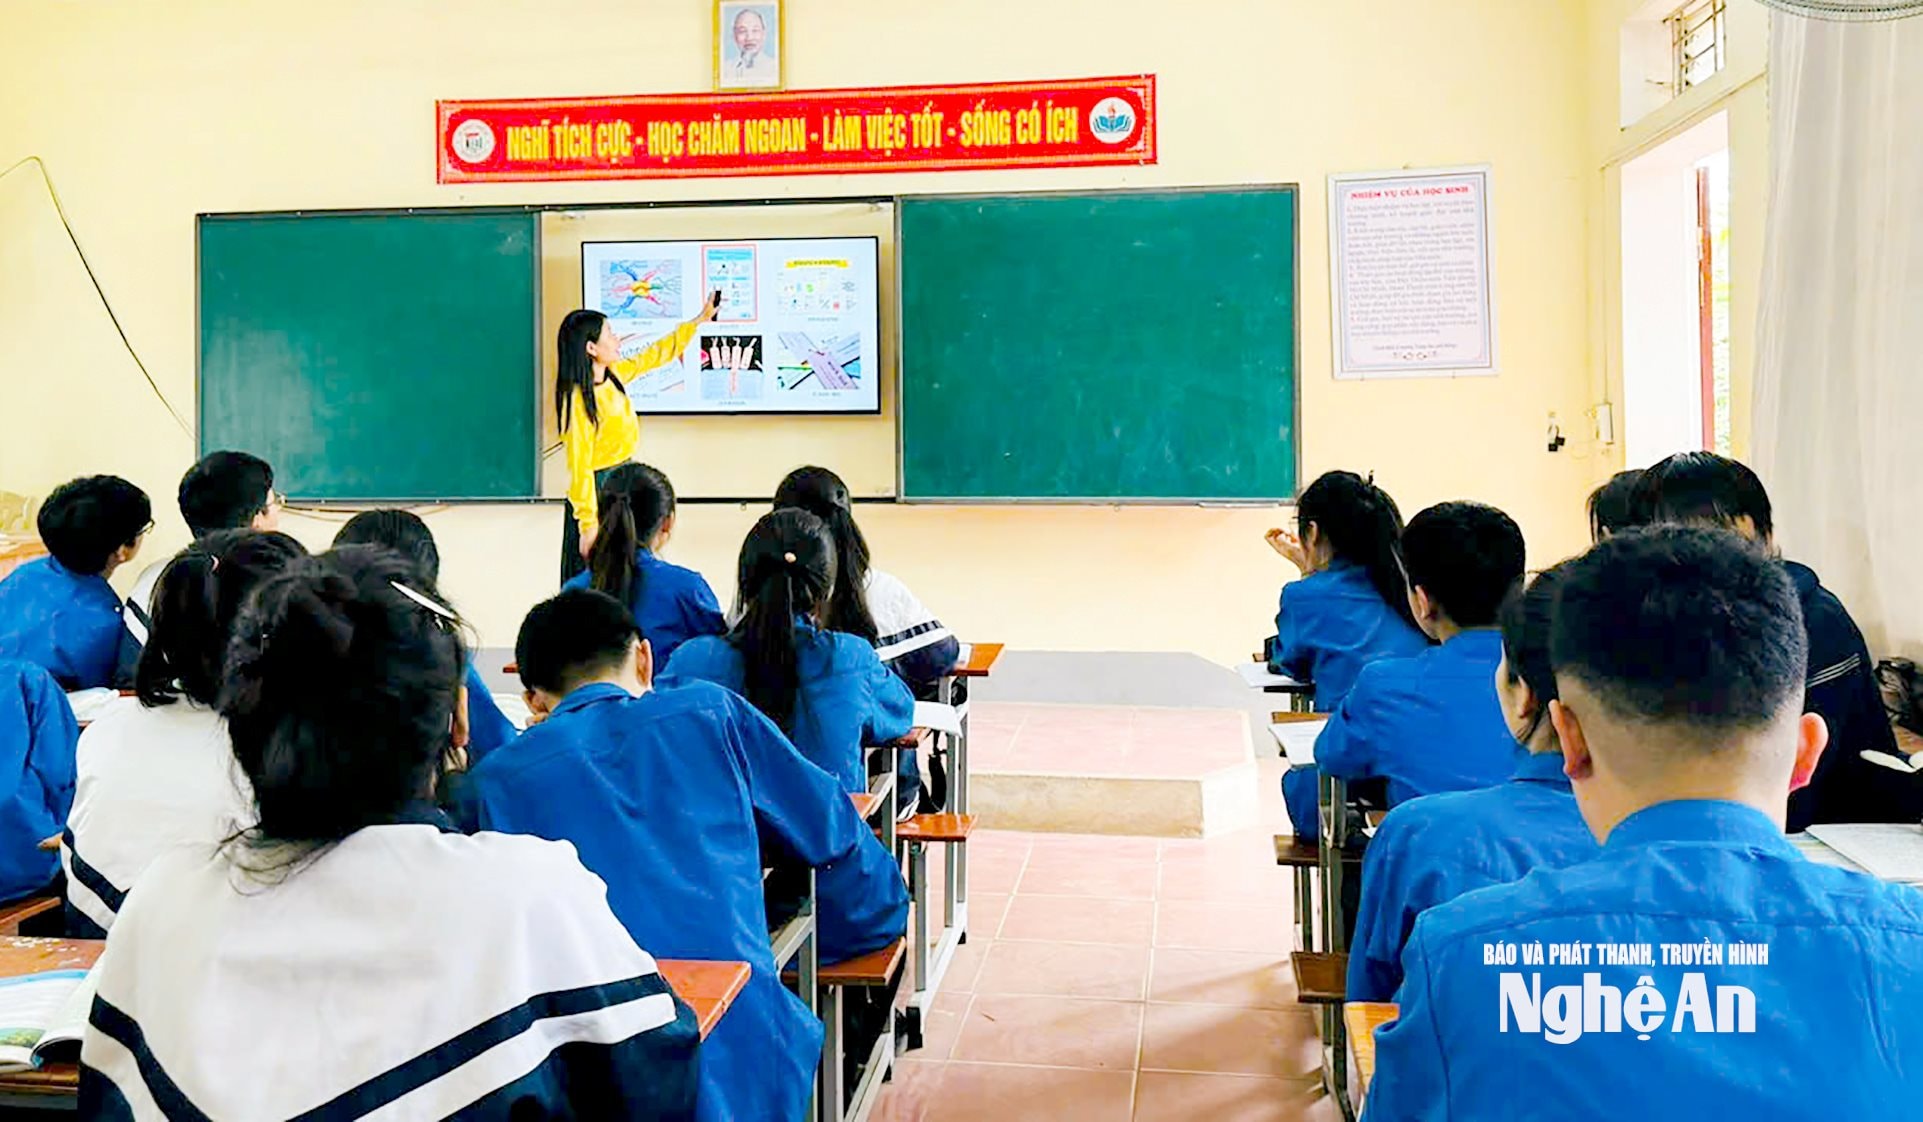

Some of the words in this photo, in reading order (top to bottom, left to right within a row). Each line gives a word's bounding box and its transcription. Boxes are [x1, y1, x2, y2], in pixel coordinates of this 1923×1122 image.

[507, 120, 550, 161] NGHĨ
[553, 116, 592, 160] TÍCH
[597, 119, 632, 164] CỰC
[648, 121, 683, 164] HỌC
[688, 113, 740, 156] CHĂM
[745, 117, 807, 153] NGOAN
[823, 108, 862, 150] LÀM
[866, 107, 906, 156] VIỆC
[910, 101, 944, 148] TỐT
[960, 99, 1011, 147] SỐNG
[1016, 101, 1042, 145] CÓ
[1046, 100, 1079, 144] ÍCH
[1351, 190, 1381, 200] NHIỆM
[1384, 189, 1398, 199] VỤ
[1400, 187, 1420, 197] CỦA
[1423, 186, 1443, 196] HỌC
[1445, 185, 1469, 194] SINH
